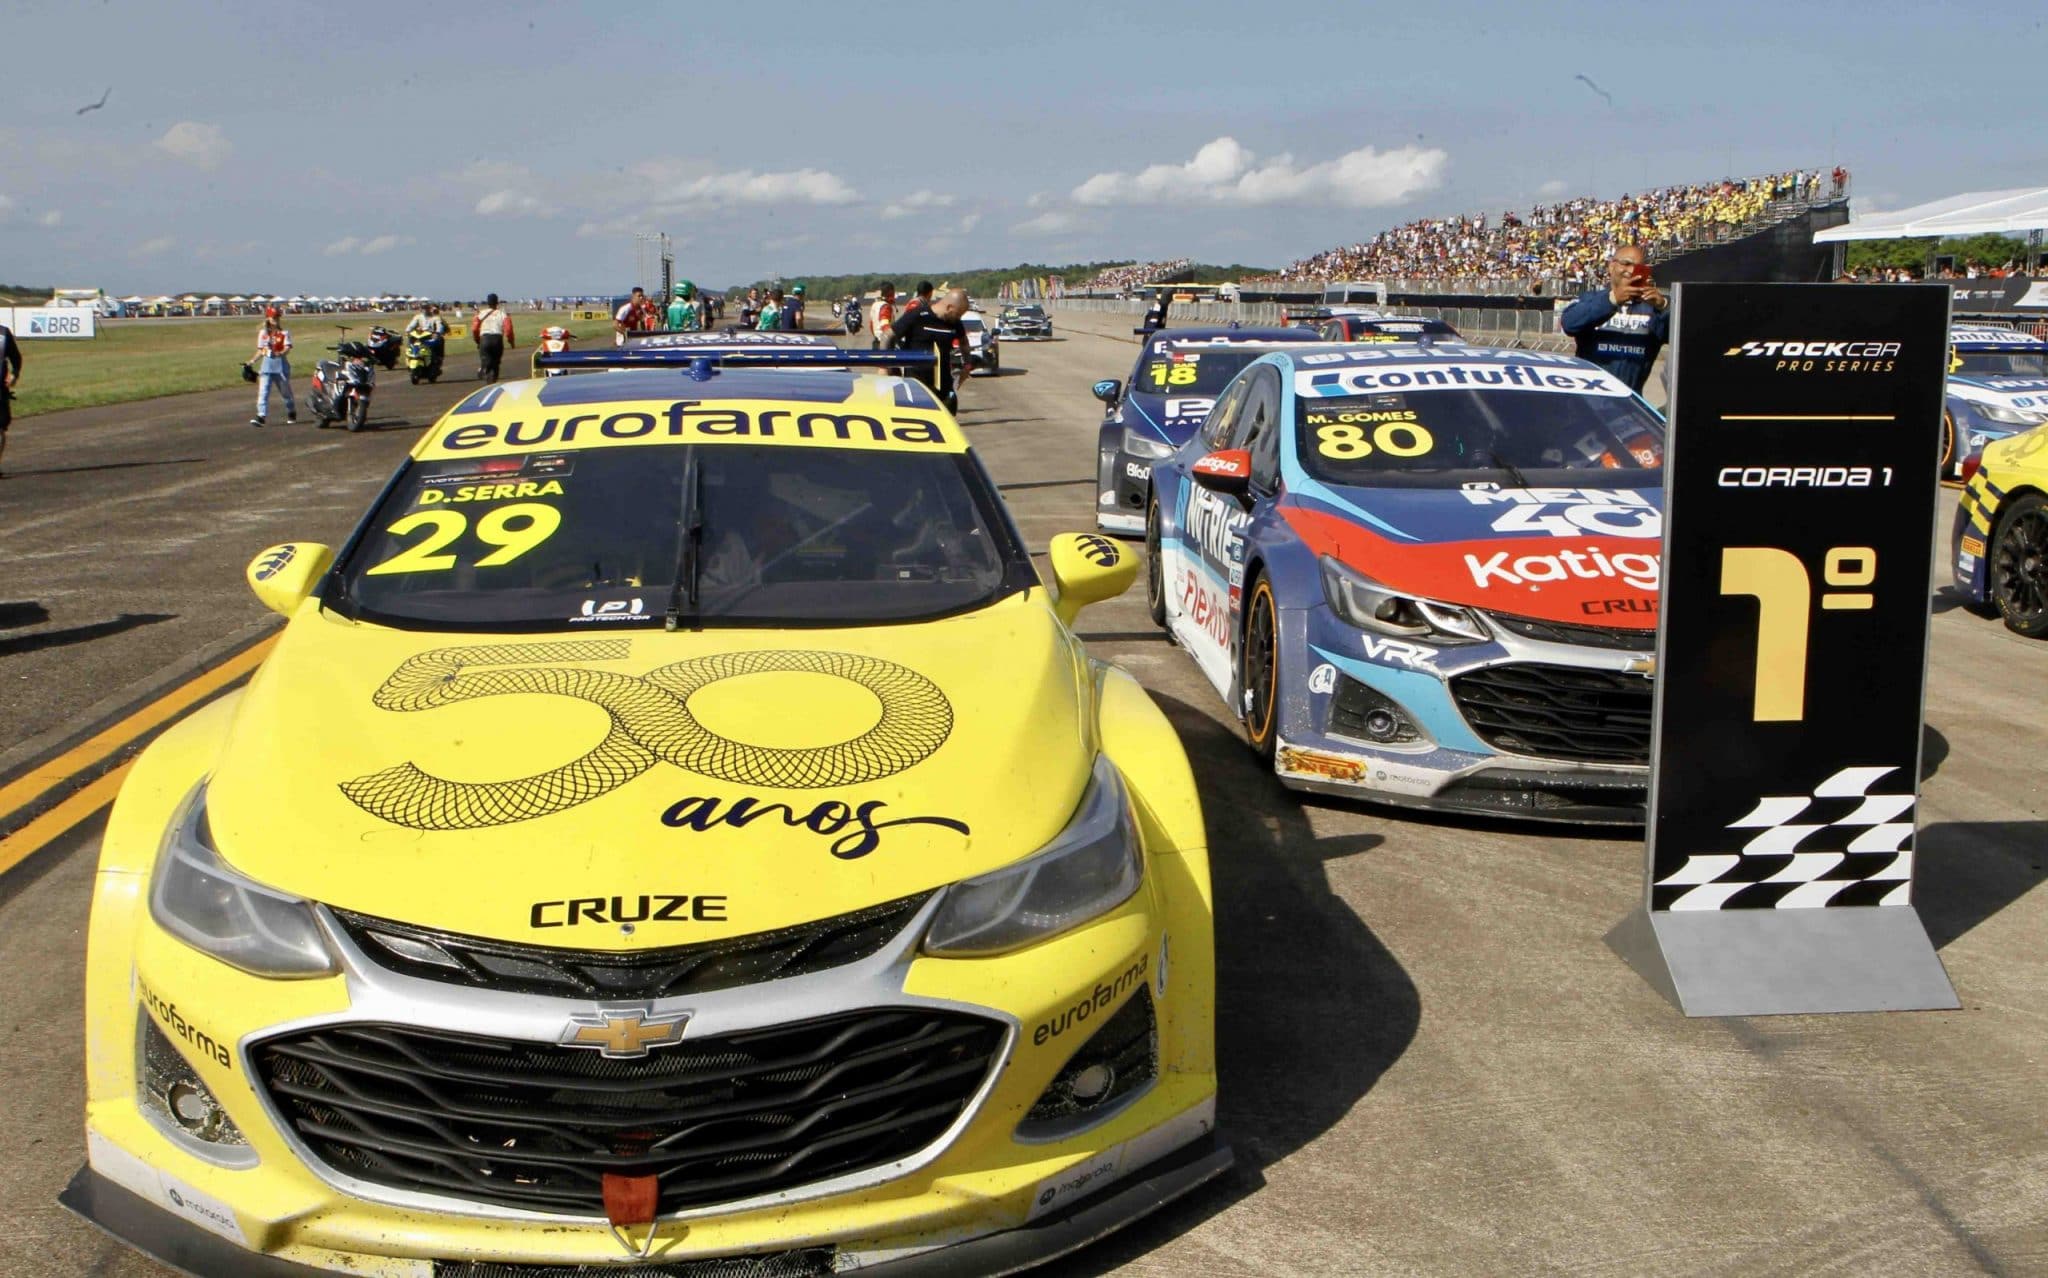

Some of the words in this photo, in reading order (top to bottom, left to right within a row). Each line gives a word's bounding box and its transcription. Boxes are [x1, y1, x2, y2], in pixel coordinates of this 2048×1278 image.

[48, 316, 80, 334] BRB
[1738, 342, 1901, 357] STOCKCAR
[1151, 367, 1198, 386] 18
[1352, 363, 1611, 392] contuflex
[1776, 361, 1812, 372] PRO
[1825, 361, 1895, 372] SERIES
[441, 401, 946, 450] eurofarma
[1307, 414, 1334, 424] M.
[1338, 410, 1417, 423] GOMES
[1316, 421, 1434, 460] 80
[1718, 467, 1871, 487] CORRIDA
[1882, 467, 1893, 487] 1
[366, 502, 562, 576] 29
[1463, 546, 1661, 592] Katig
[1581, 599, 1658, 615] CRU
[339, 638, 954, 831] 50
[660, 796, 970, 860] anos
[530, 895, 728, 928] CRUZE
[1033, 954, 1148, 1046] eurofarma
